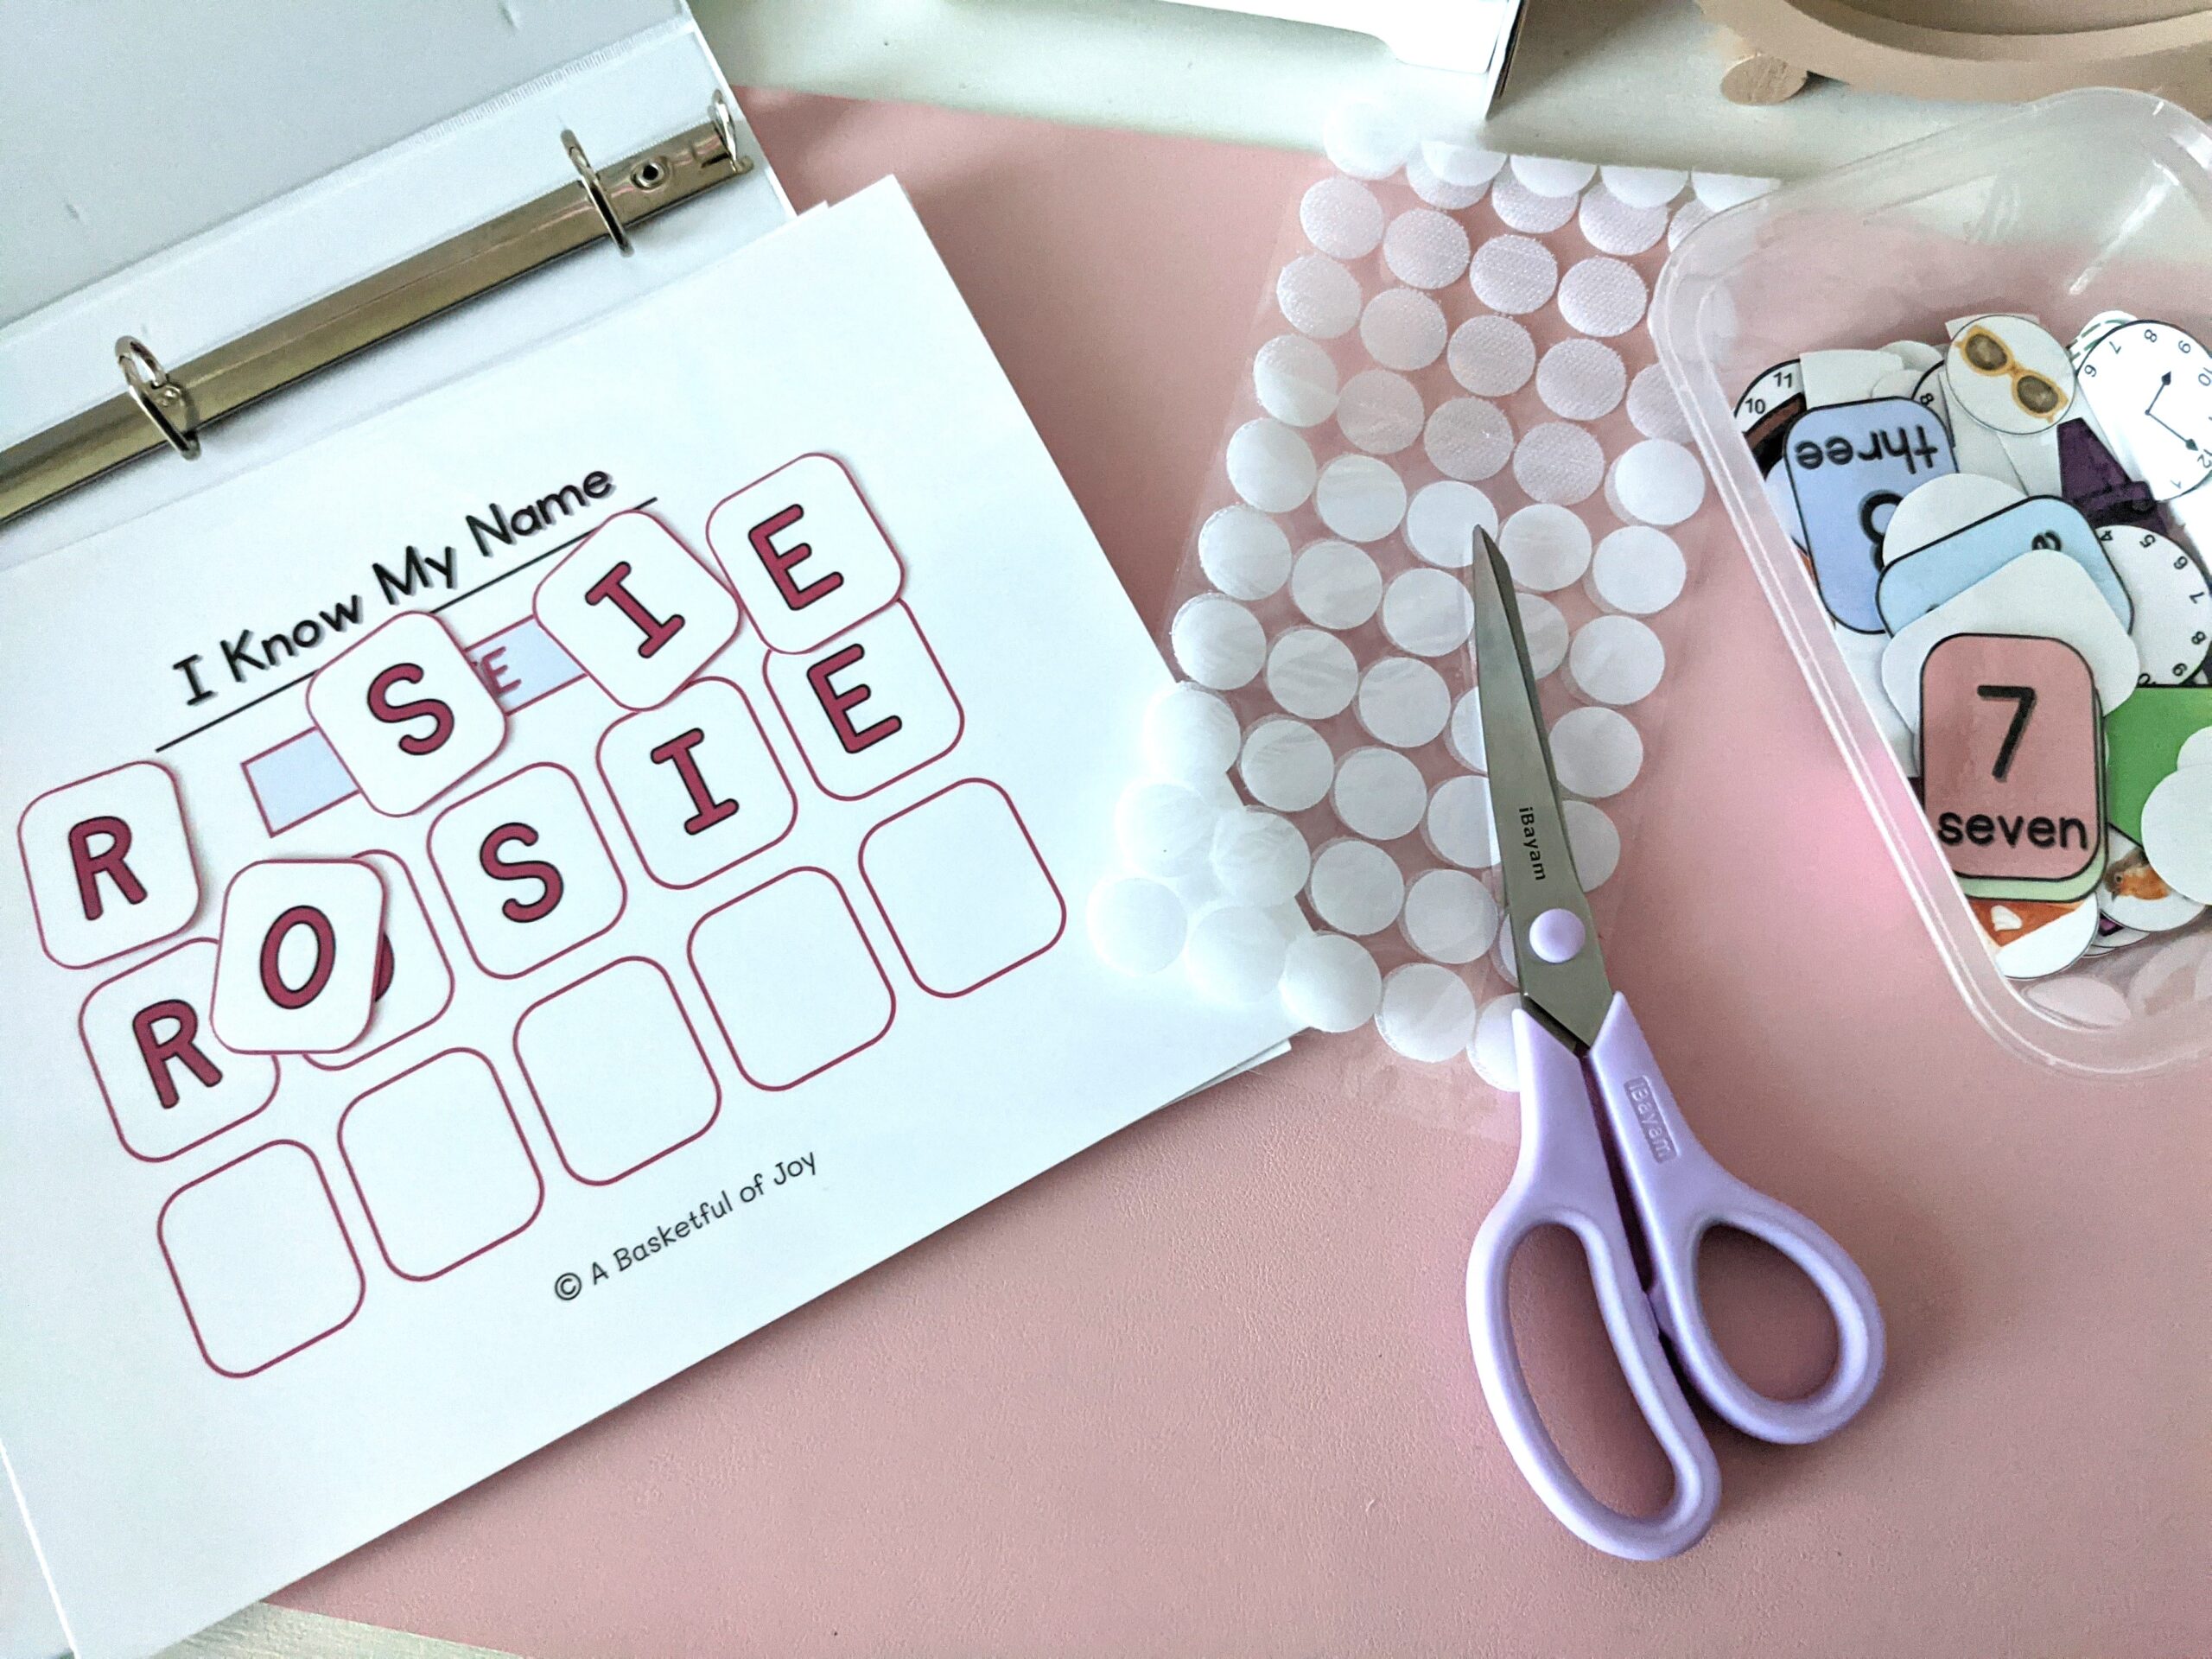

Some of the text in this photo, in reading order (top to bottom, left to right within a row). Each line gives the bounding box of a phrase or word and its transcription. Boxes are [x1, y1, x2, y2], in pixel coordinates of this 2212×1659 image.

[2144, 329, 2158, 343] 8
[2109, 341, 2122, 354] 7
[2178, 340, 2191, 354] 9
[2084, 364, 2097, 378] 6
[1773, 372, 1793, 388] 11
[1745, 398, 1766, 414] 10
[1794, 424, 1938, 474] three
[2139, 534, 2156, 549] 5
[2173, 556, 2188, 570] 6
[173, 470, 616, 706] I Know My Name
[2189, 591, 2205, 604] 7
[2191, 631, 2207, 645] 8
[474, 645, 522, 696] E
[2172, 663, 2187, 677] 9
[1977, 684, 2037, 782] 7
[68, 816, 148, 920] R
[259, 905, 336, 1009] O
[367, 663, 454, 756] S
[585, 561, 685, 658] I
[747, 504, 844, 611] E
[1937, 812, 2088, 850] seven
[1519, 807, 1546, 880] iBayam
[132, 643, 903, 1109] R S I E
[1628, 1082, 1672, 1158] iBayam
[591, 1262, 609, 1285] A
[613, 1190, 734, 1272] Basketful
[739, 1173, 765, 1204] of
[773, 1152, 817, 1185] Joy
